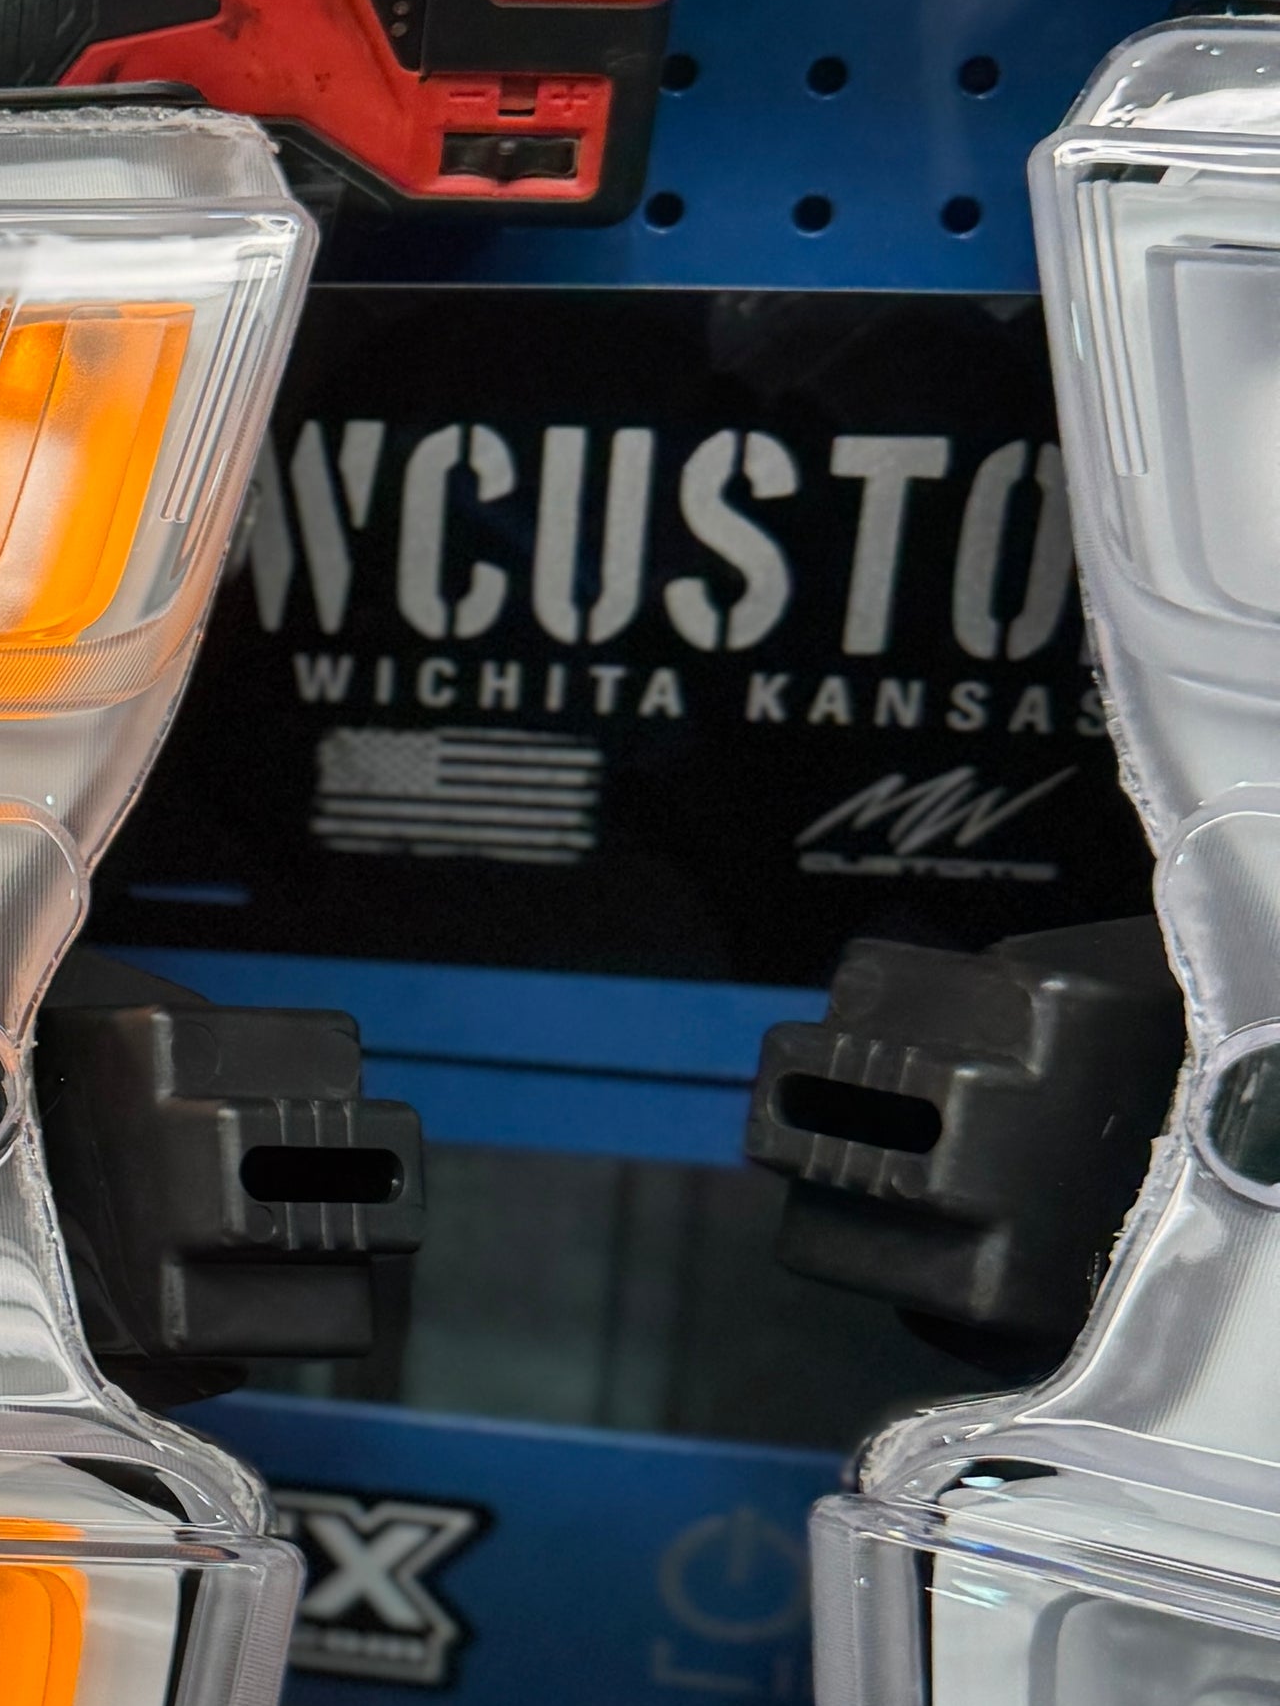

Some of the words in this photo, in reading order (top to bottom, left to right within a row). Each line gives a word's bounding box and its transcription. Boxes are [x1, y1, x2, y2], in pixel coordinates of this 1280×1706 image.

[246, 419, 1084, 660] WCUSTO
[293, 653, 684, 720] WICHITA
[746, 672, 1105, 737] KANSAS
